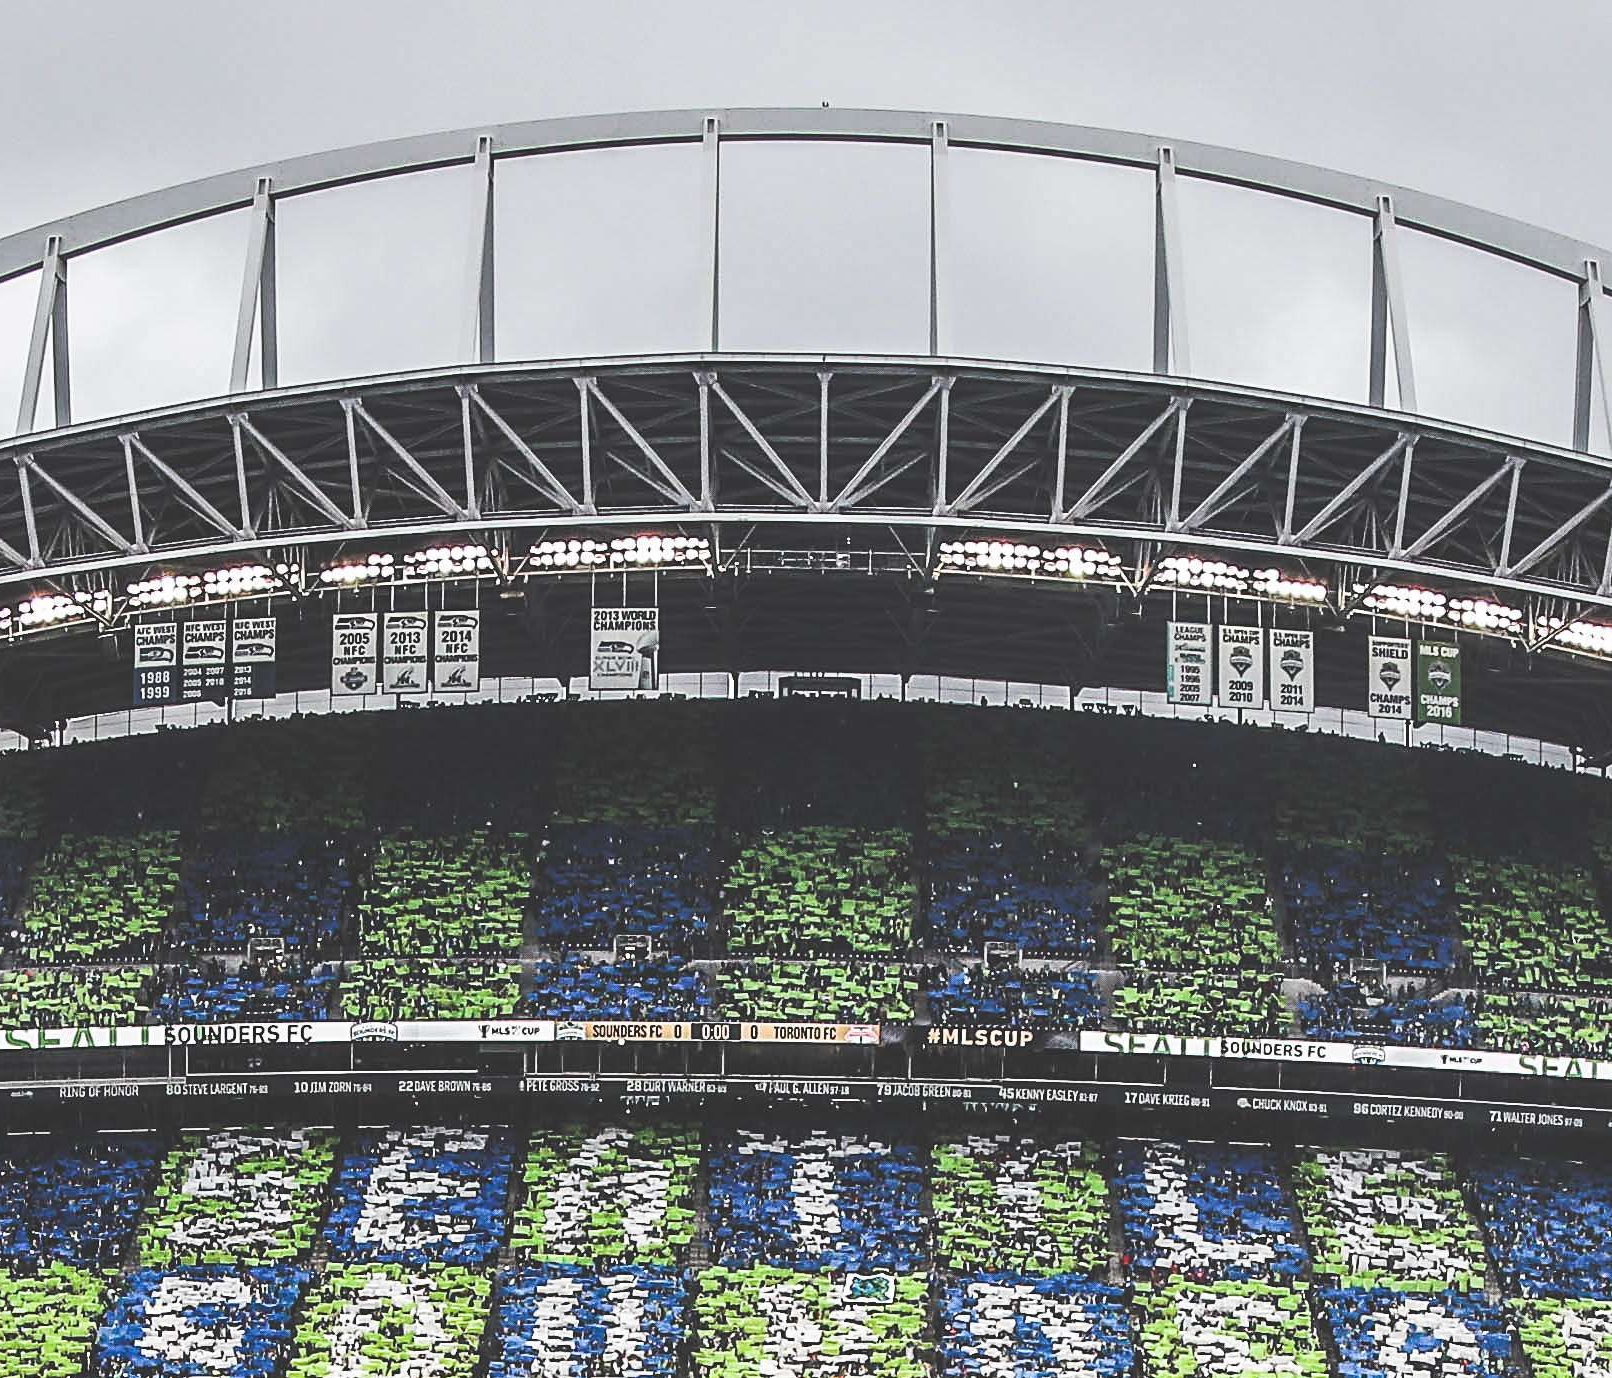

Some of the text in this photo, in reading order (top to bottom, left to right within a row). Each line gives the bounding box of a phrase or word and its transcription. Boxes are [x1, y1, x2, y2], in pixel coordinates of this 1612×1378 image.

[594, 611, 656, 620] 2013 WORLD
[153, 625, 175, 634] WEST
[201, 623, 225, 631] WEST
[593, 621, 656, 631] CHAMPIONS
[136, 635, 175, 645] CHAMPS
[185, 632, 225, 643] CHAMPS
[234, 630, 275, 640] CHAMPS
[340, 633, 370, 645] 2005
[390, 632, 421, 644] 2013
[441, 630, 472, 643] 2014
[1174, 633, 1206, 642] CHAMPS
[1223, 634, 1260, 645] CHAMPS
[446, 644, 468, 653] NFC
[1273, 638, 1310, 649] CHAMPS
[343, 646, 366, 655] NFC
[394, 645, 416, 655] NFC
[1372, 647, 1408, 659] SHIELD
[1419, 645, 1459, 658] MLS CUP
[593, 660, 639, 672] XLVIII
[140, 671, 170, 684] 1988
[1229, 681, 1253, 691] 2009
[1280, 684, 1303, 694] 2011
[140, 686, 170, 699] 1999
[1229, 692, 1253, 703] 2010
[1280, 695, 1303, 706] 2014
[1370, 693, 1410, 705] CHAMPS
[1420, 694, 1459, 707] CHAMPS
[1379, 704, 1402, 714] 2014
[1427, 705, 1452, 718] 2016
[165, 1024, 313, 1045] SOUNDERS FC
[491, 1027, 541, 1036] MLS CUP
[592, 1024, 682, 1038] SOUNDERS FC 0
[701, 1025, 729, 1040] 0:00
[750, 1025, 837, 1041] 0 TORONTO FC
[927, 1028, 1035, 1047] #MLSCUP
[1221, 1040, 1326, 1058] SOUNDERS FC
[60, 1084, 139, 1098] RING OF HONOR
[166, 1083, 248, 1095] 80 STEVE LARGENT
[294, 1082, 352, 1093] 10 JIM ZORN
[399, 1081, 471, 1092] 22 DAVE BROWN
[527, 1081, 579, 1092] PETE GROSS
[626, 1082, 706, 1093] 28 CURT WARNER
[769, 1082, 790, 1095] PAUL
[803, 1083, 830, 1095] ALLEN
[877, 1084, 951, 1098] 79 JACOB GREEN
[999, 1088, 1078, 1102] 45 KENNY EASLEY
[1125, 1092, 1189, 1106] 17 DAVE KRIEG
[1252, 1098, 1307, 1112] CHUCK KNOX
[1353, 1102, 1443, 1119] 96 CORTEZ KENNEDY
[1490, 1111, 1563, 1127] 71 WALTER JONES
